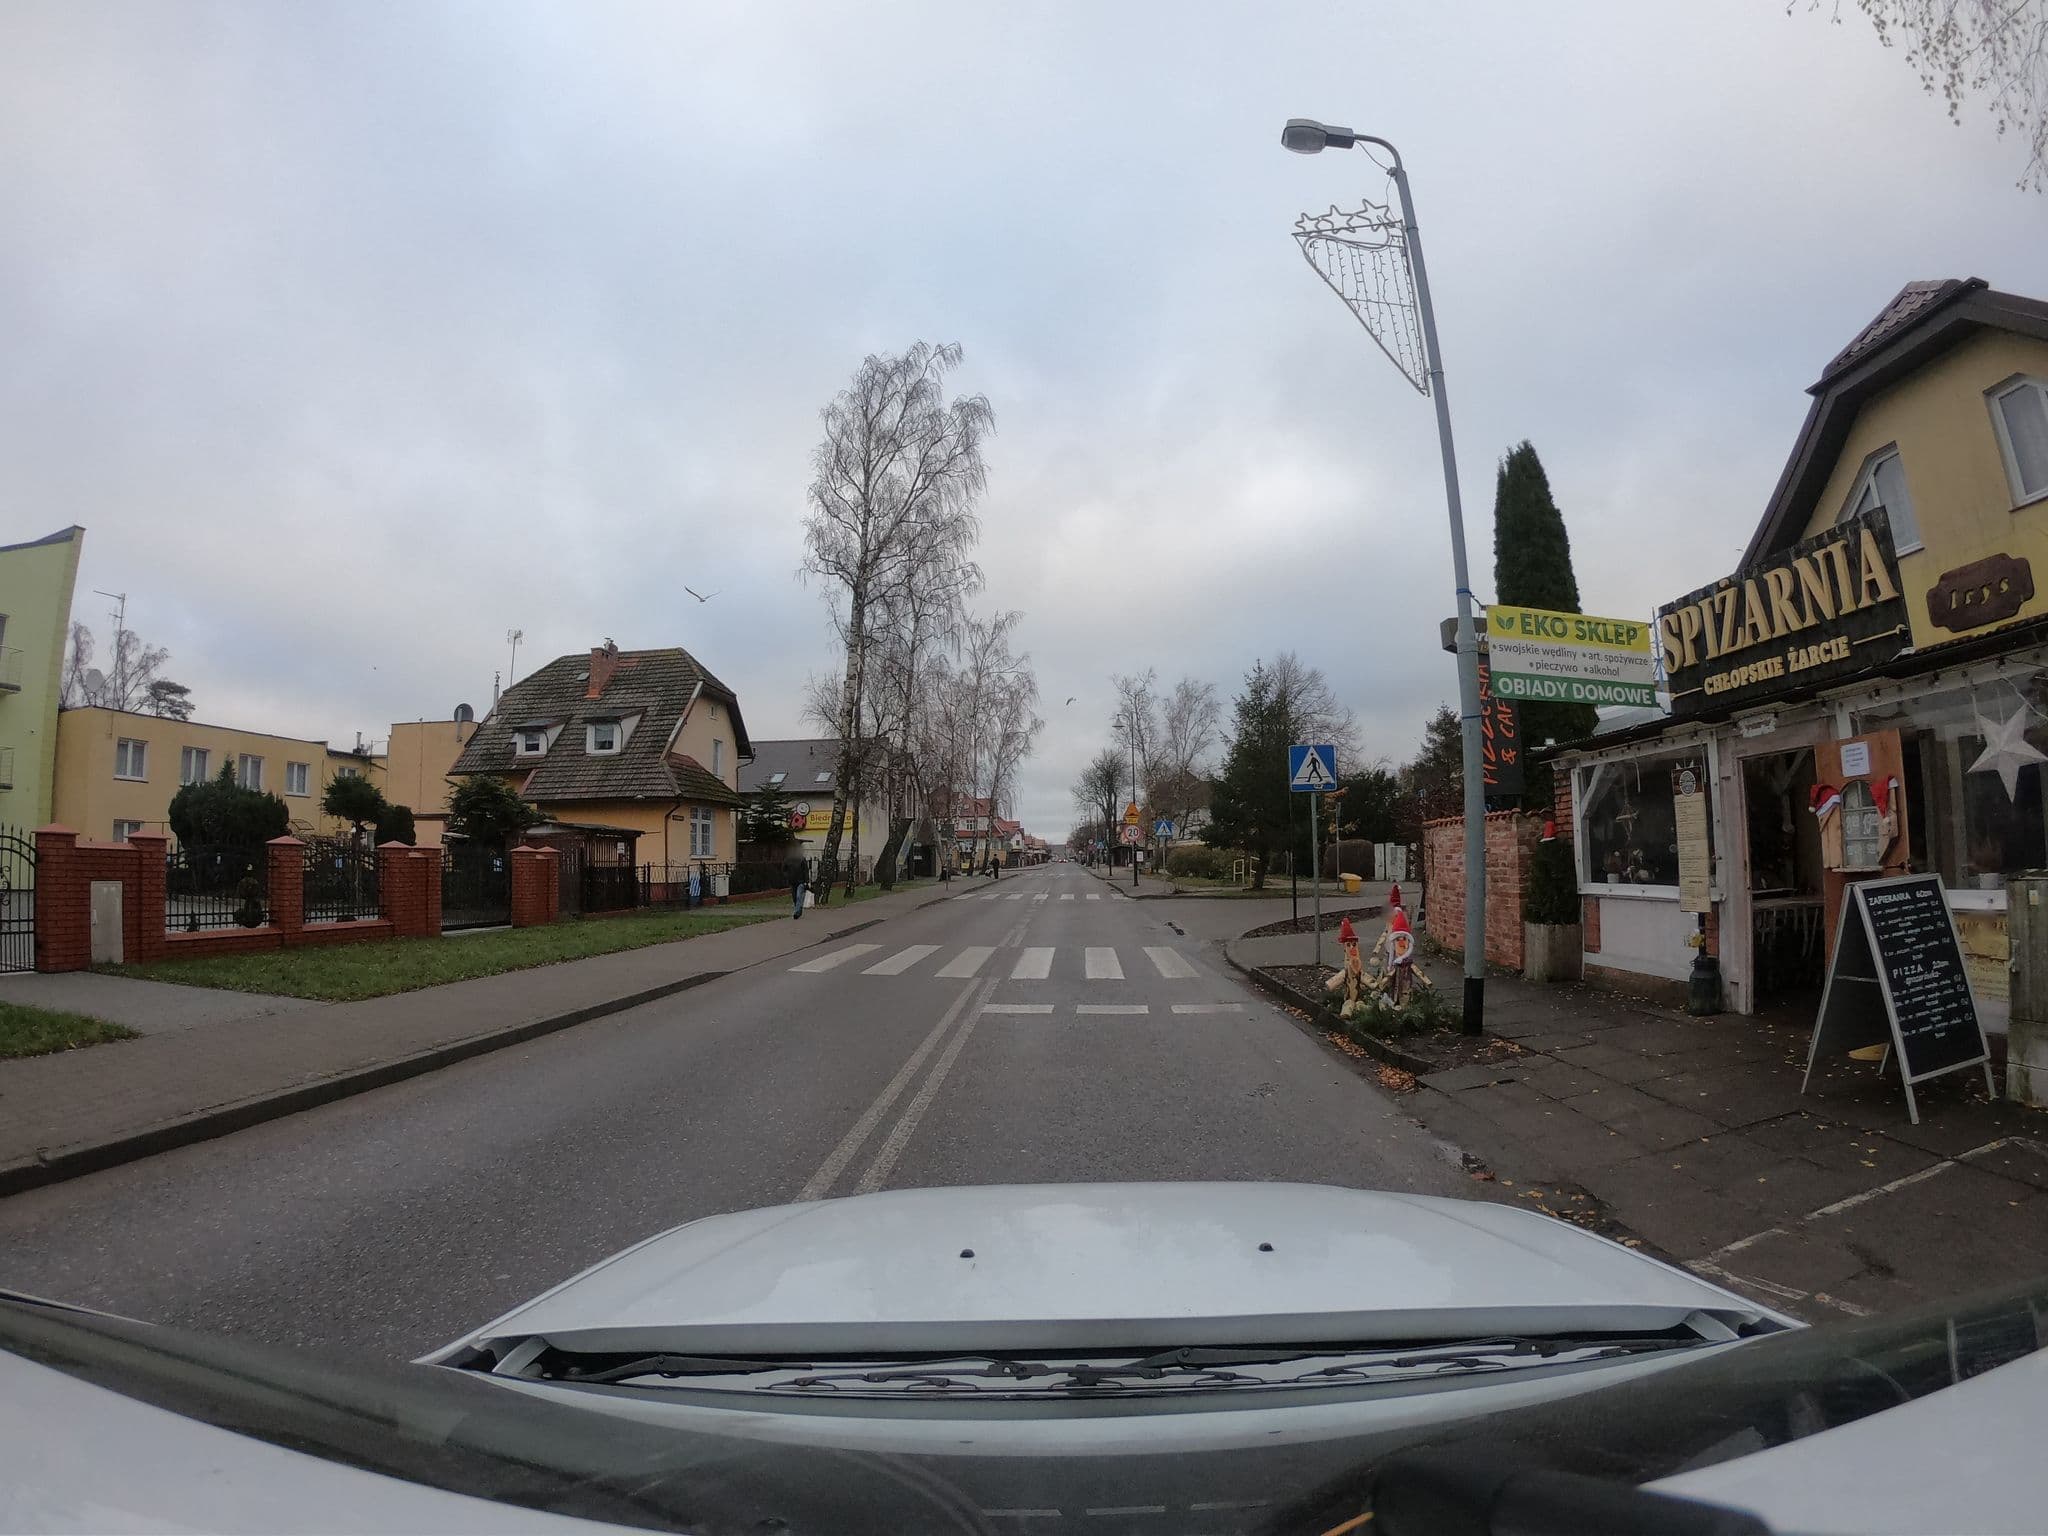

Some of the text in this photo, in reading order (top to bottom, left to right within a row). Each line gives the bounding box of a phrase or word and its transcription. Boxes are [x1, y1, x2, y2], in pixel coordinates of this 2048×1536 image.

[1661, 529, 1900, 674] SPIŻARNIA
[1520, 613, 1638, 645] EKO SKLEP
[1498, 642, 1540, 655] swojskie
[1542, 647, 1577, 659] wędliny
[1604, 653, 1649, 666] spożywcze
[1704, 636, 1851, 696] CHŁOPSKIE ŻARCIE
[1535, 661, 1620, 677] pieczywo alkohol
[1498, 677, 1652, 705] OBIADY DOMOWE
[1495, 698, 1515, 739] CAF
[1127, 828, 1139, 837] 20
[1892, 963, 1924, 979] PIZZA
